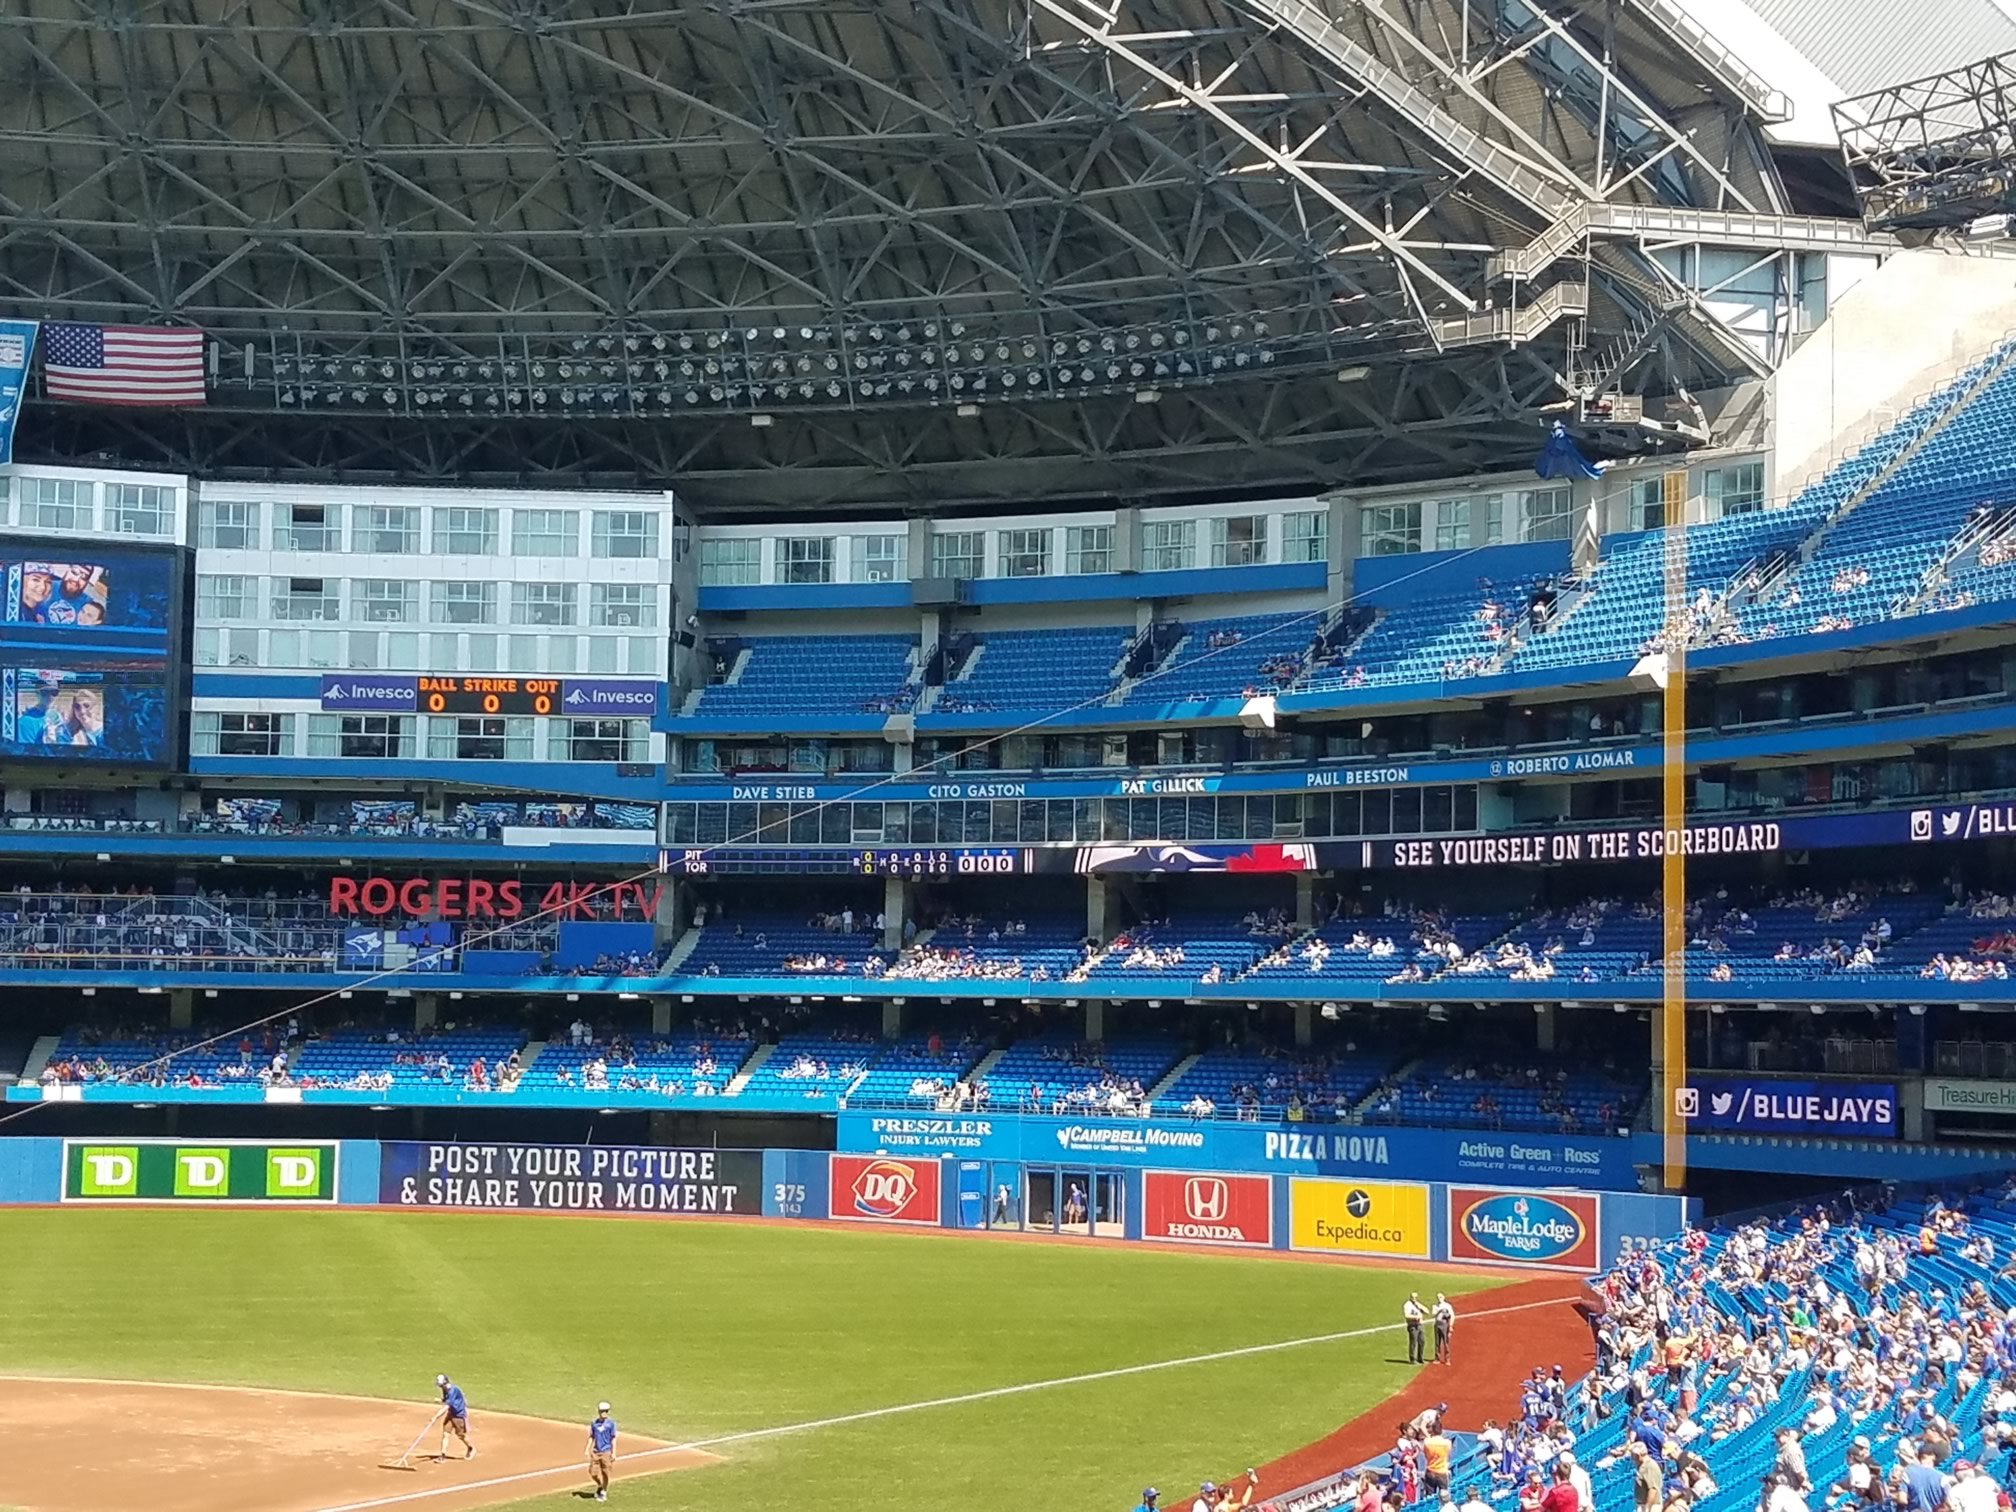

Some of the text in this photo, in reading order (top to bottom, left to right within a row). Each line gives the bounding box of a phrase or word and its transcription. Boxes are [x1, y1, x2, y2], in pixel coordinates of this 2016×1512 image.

[352, 684, 415, 700] Invesco
[419, 678, 559, 693] BALL STRIKE OUT
[429, 694, 550, 713] 0 0 0
[592, 688, 655, 704] Invesco
[1507, 756, 1569, 775] ROBERTO
[1575, 751, 1635, 769] ALOMAR
[1122, 778, 1206, 794] PAT GILLICK
[1307, 768, 1409, 786] PAUL BEESTON
[733, 786, 816, 799] DAVE STIEB
[929, 784, 1026, 798] CITO GASTON
[1394, 823, 1781, 867] SEE YOURSELF ON THE SCOREBOARD
[685, 850, 703, 860] PIT
[685, 862, 707, 873] TOR
[330, 876, 665, 921] ROGERS 4K TV
[872, 1118, 993, 1136] PRESZLER
[1070, 1125, 1205, 1147] CAMPBELL MOVING
[880, 1135, 982, 1147] INJURY LAWYERS
[1265, 1132, 1390, 1165] PIZZA NOVA
[1458, 1141, 1505, 1158] Active
[1510, 1144, 1551, 1161] Green
[1565, 1147, 1600, 1164] Ross
[87, 1155, 316, 1187] TD TD TD
[429, 1146, 715, 1180] POST YOUR PICTURE
[1458, 1160, 1505, 1170] COMPLETE
[1508, 1163, 1526, 1171] TIRE
[1537, 1164, 1562, 1173] AUTO
[1564, 1166, 1601, 1175] CENTRE
[400, 1177, 738, 1212] & SHARE YOUR MOMENT
[774, 1184, 806, 1202] 375
[864, 1174, 907, 1207] DQ
[779, 1203, 802, 1214] 1143
[1168, 1223, 1246, 1241] HONDA
[1316, 1220, 1402, 1243] Expedia.ca
[1504, 1236, 1542, 1251] FARMS
